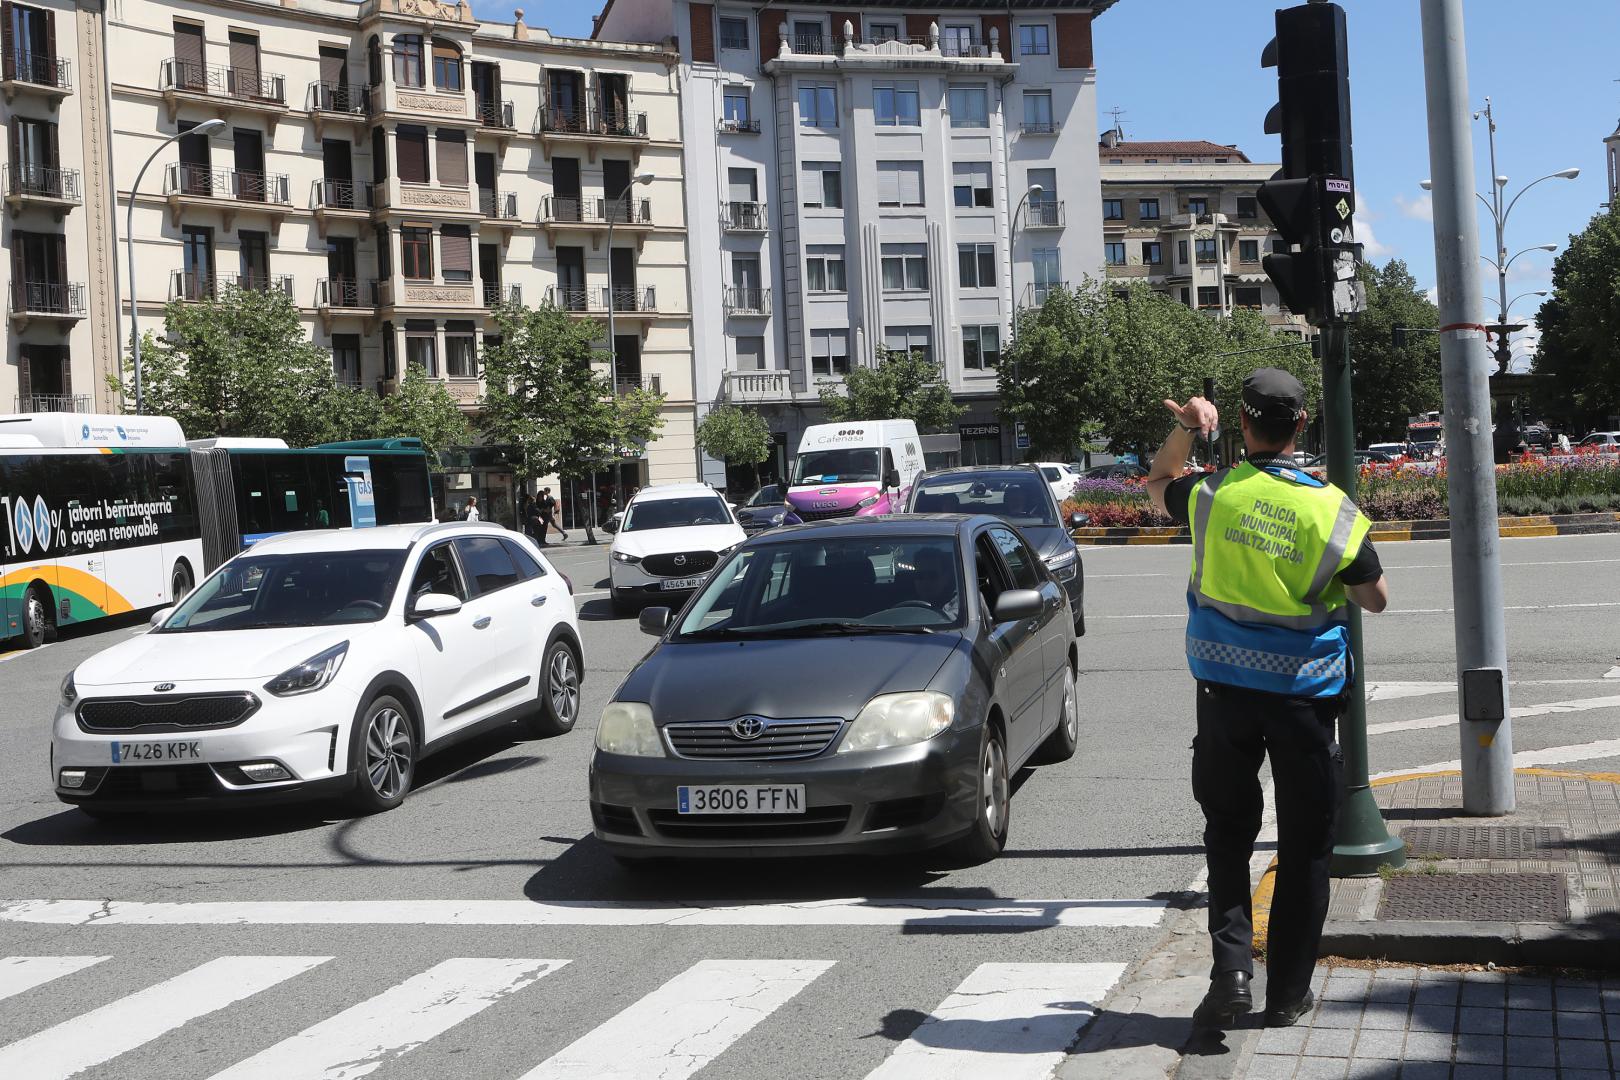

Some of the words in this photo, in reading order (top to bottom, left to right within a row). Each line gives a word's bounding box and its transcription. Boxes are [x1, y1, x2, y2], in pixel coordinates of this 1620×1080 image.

[817, 434, 864, 444] Cafenasa
[960, 425, 1000, 435] TEZENIS
[358, 481, 372, 495] GAS
[68, 500, 103, 528] jatorri
[104, 496, 173, 521] berriztagarria
[812, 501, 839, 509] IVECO
[1253, 499, 1297, 525] POLICIA
[71, 524, 107, 549] origen
[109, 517, 159, 541] renovable
[1239, 513, 1297, 544] MUNICIPAL
[1224, 527, 1304, 564] UDALTZAINGOA
[122, 743, 163, 760] 7426
[168, 741, 200, 759] KPK
[694, 788, 749, 810] 3606
[757, 787, 799, 810] FFN
